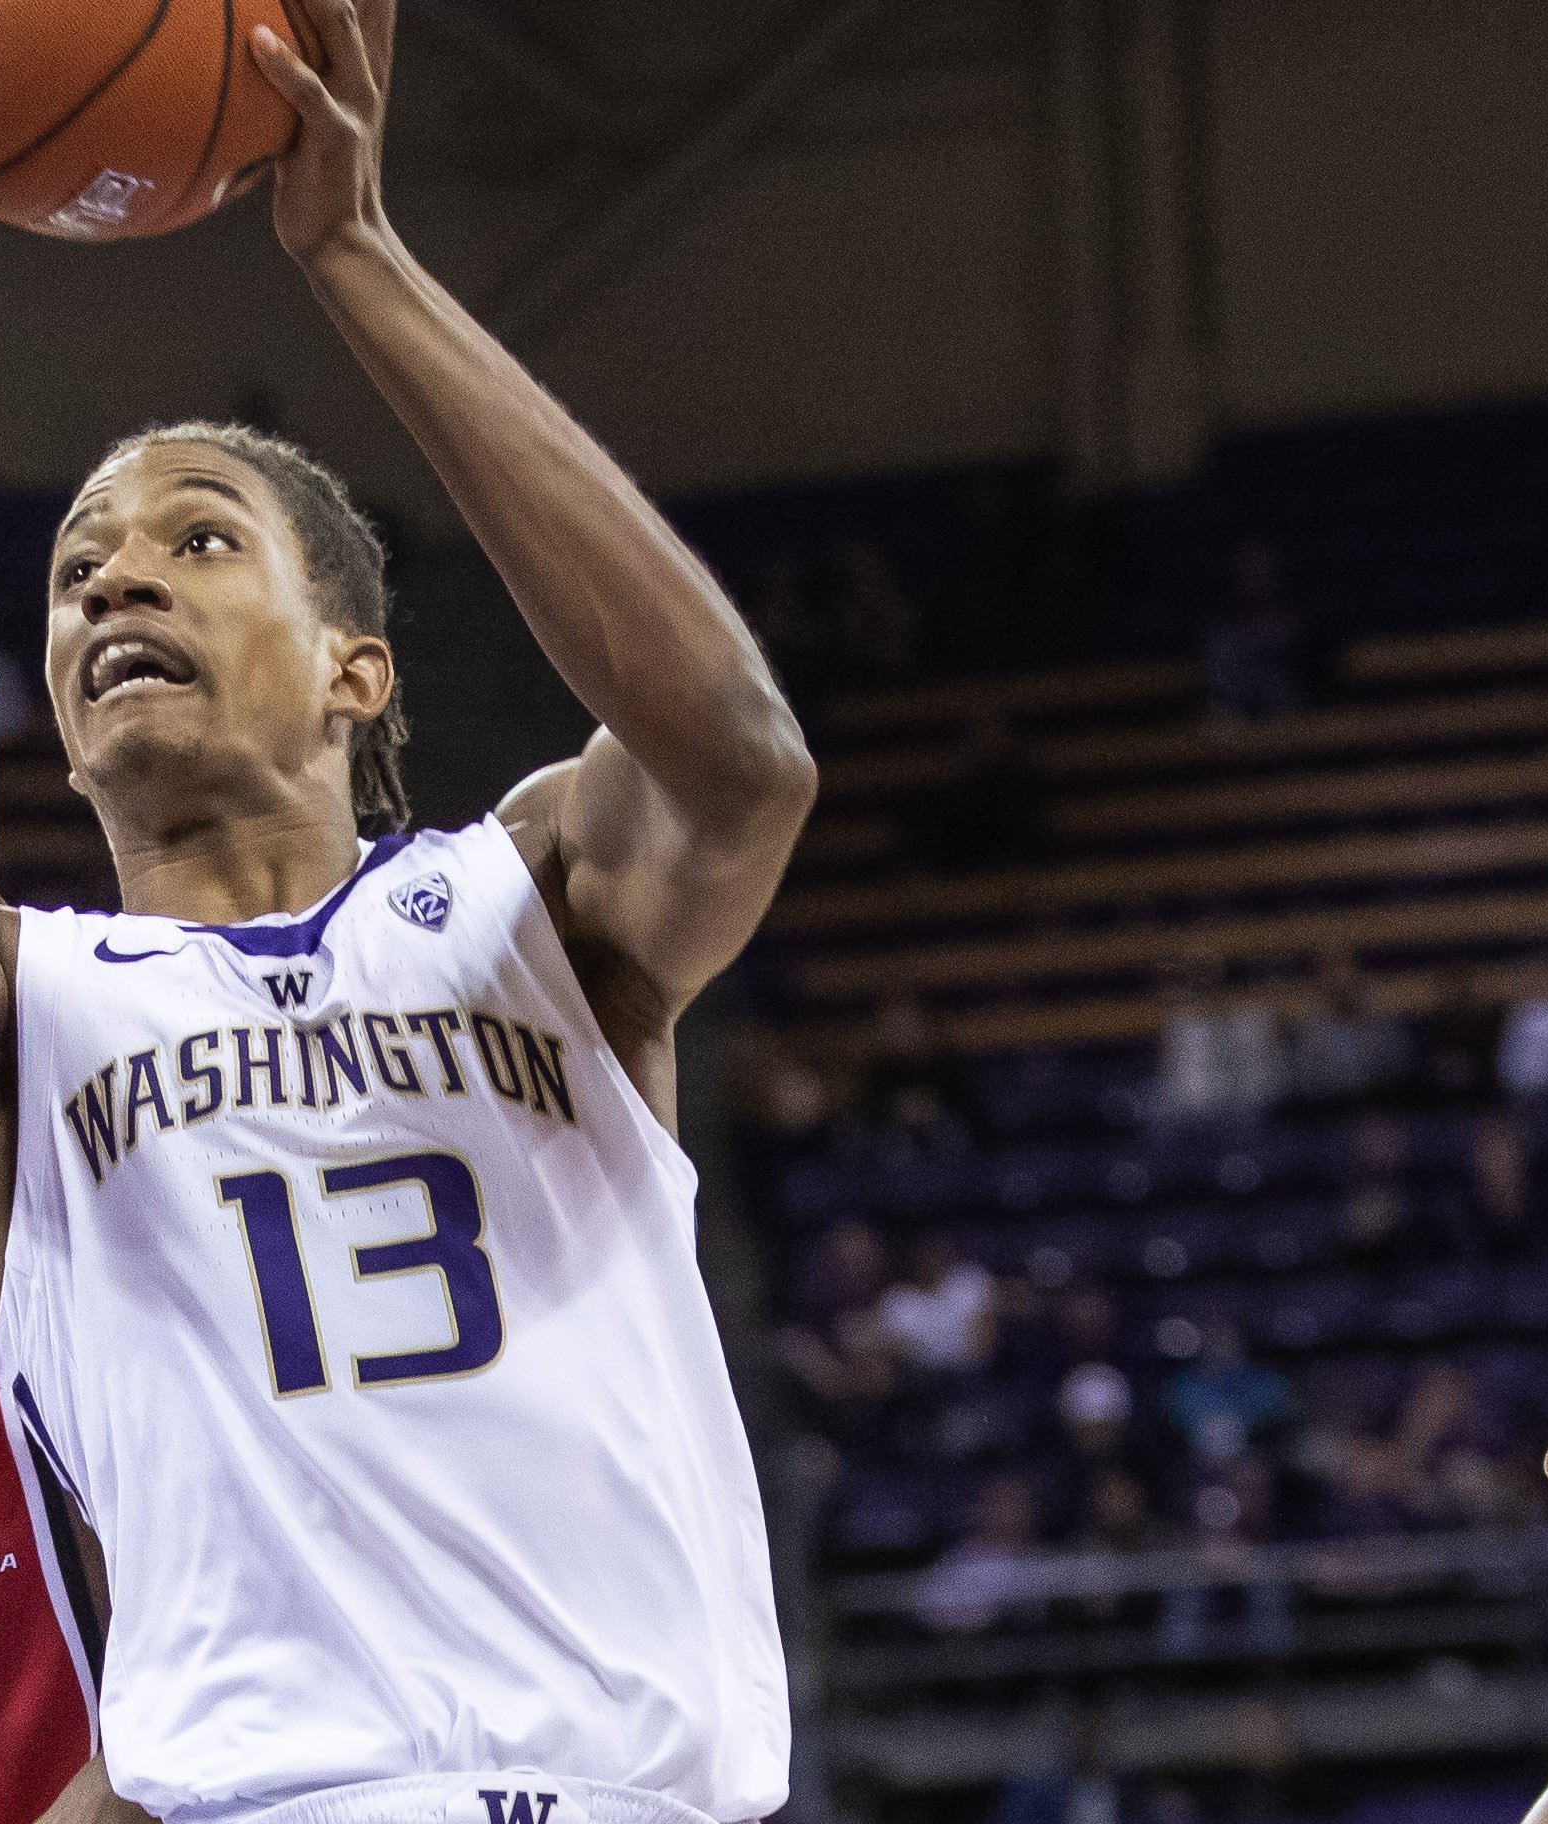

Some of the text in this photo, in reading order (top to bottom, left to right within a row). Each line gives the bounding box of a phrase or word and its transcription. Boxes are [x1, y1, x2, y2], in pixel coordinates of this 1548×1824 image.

[261, 970, 314, 1008] W
[61, 1006, 582, 1190] WASHINGTON
[214, 1149, 507, 1400] 13
